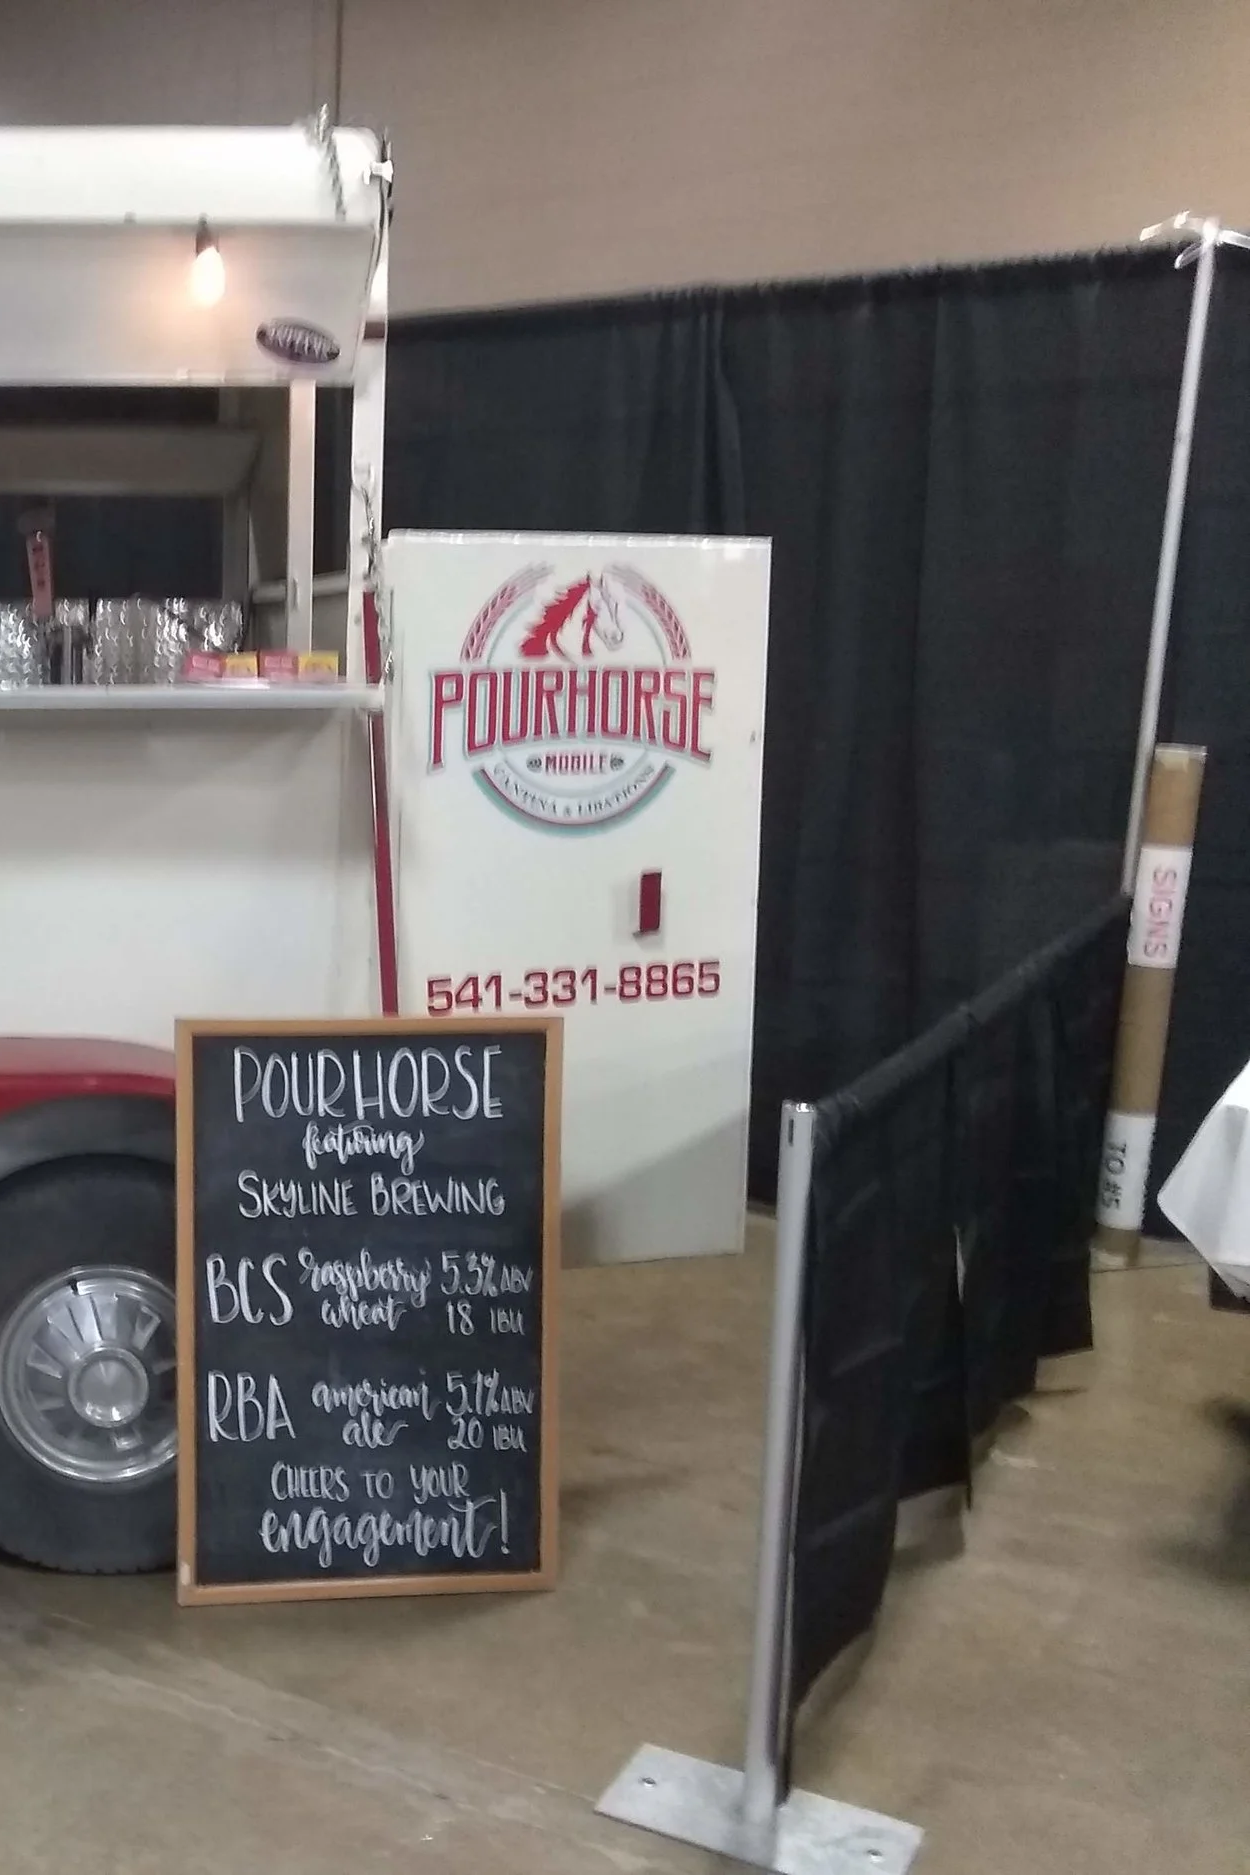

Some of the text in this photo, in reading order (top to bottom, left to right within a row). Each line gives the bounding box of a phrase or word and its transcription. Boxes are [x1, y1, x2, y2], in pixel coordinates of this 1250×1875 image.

[427, 668, 717, 774] POURHORSE
[545, 753, 607, 775] MOBILE
[1144, 866, 1177, 957] SIGNS
[426, 960, 721, 1018] 541-331-8865
[234, 1045, 504, 1121] POURHORSE
[302, 1120, 425, 1175] featuring
[238, 1169, 506, 1219] SKYLINE BREWING
[206, 1252, 295, 1326] BCS
[297, 1246, 432, 1308] raspberry
[321, 1294, 408, 1332] wheat
[446, 1300, 475, 1336] 18
[207, 1370, 296, 1442] RBA
[311, 1368, 443, 1421] american
[341, 1410, 410, 1449] ale
[447, 1416, 485, 1450] 20
[270, 1460, 471, 1505] CHEERS TO YOUR
